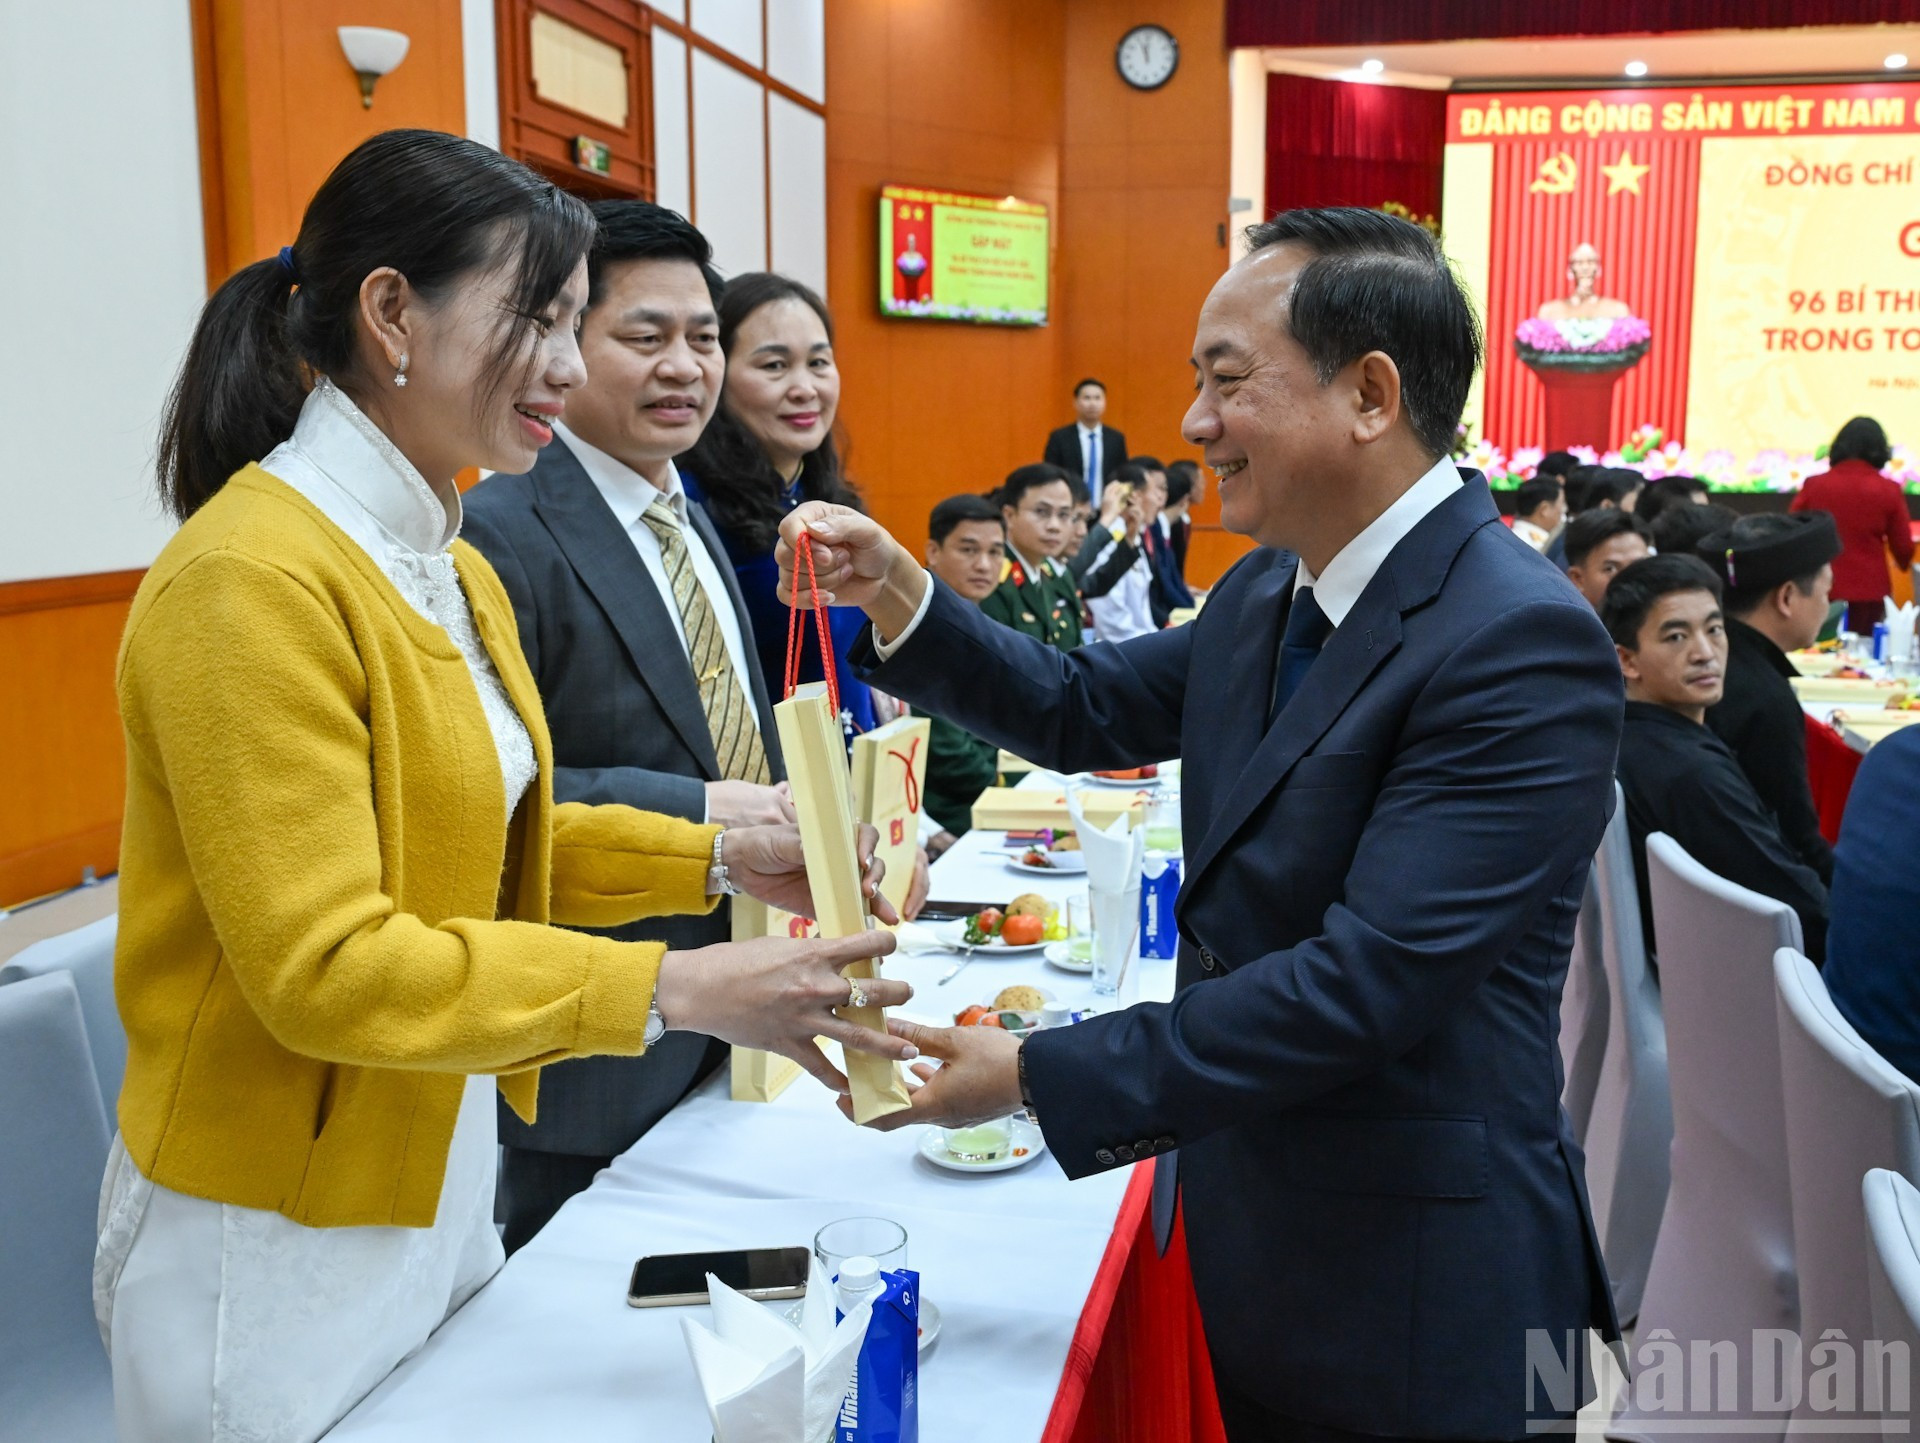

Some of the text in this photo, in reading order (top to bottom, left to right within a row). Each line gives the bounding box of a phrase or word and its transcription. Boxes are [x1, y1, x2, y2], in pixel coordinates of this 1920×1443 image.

[1460, 98, 1551, 136] ĐẢNG
[1560, 99, 1652, 138] CỘNG
[1661, 93, 1733, 131] SẢN
[1741, 94, 1815, 134] VIỆT
[1822, 98, 1905, 128] NAM
[1765, 155, 1914, 186] ĐỒNG CHÍ
[1788, 282, 1920, 314] 96 BÍ TH
[1762, 328, 1873, 352] TRONG
